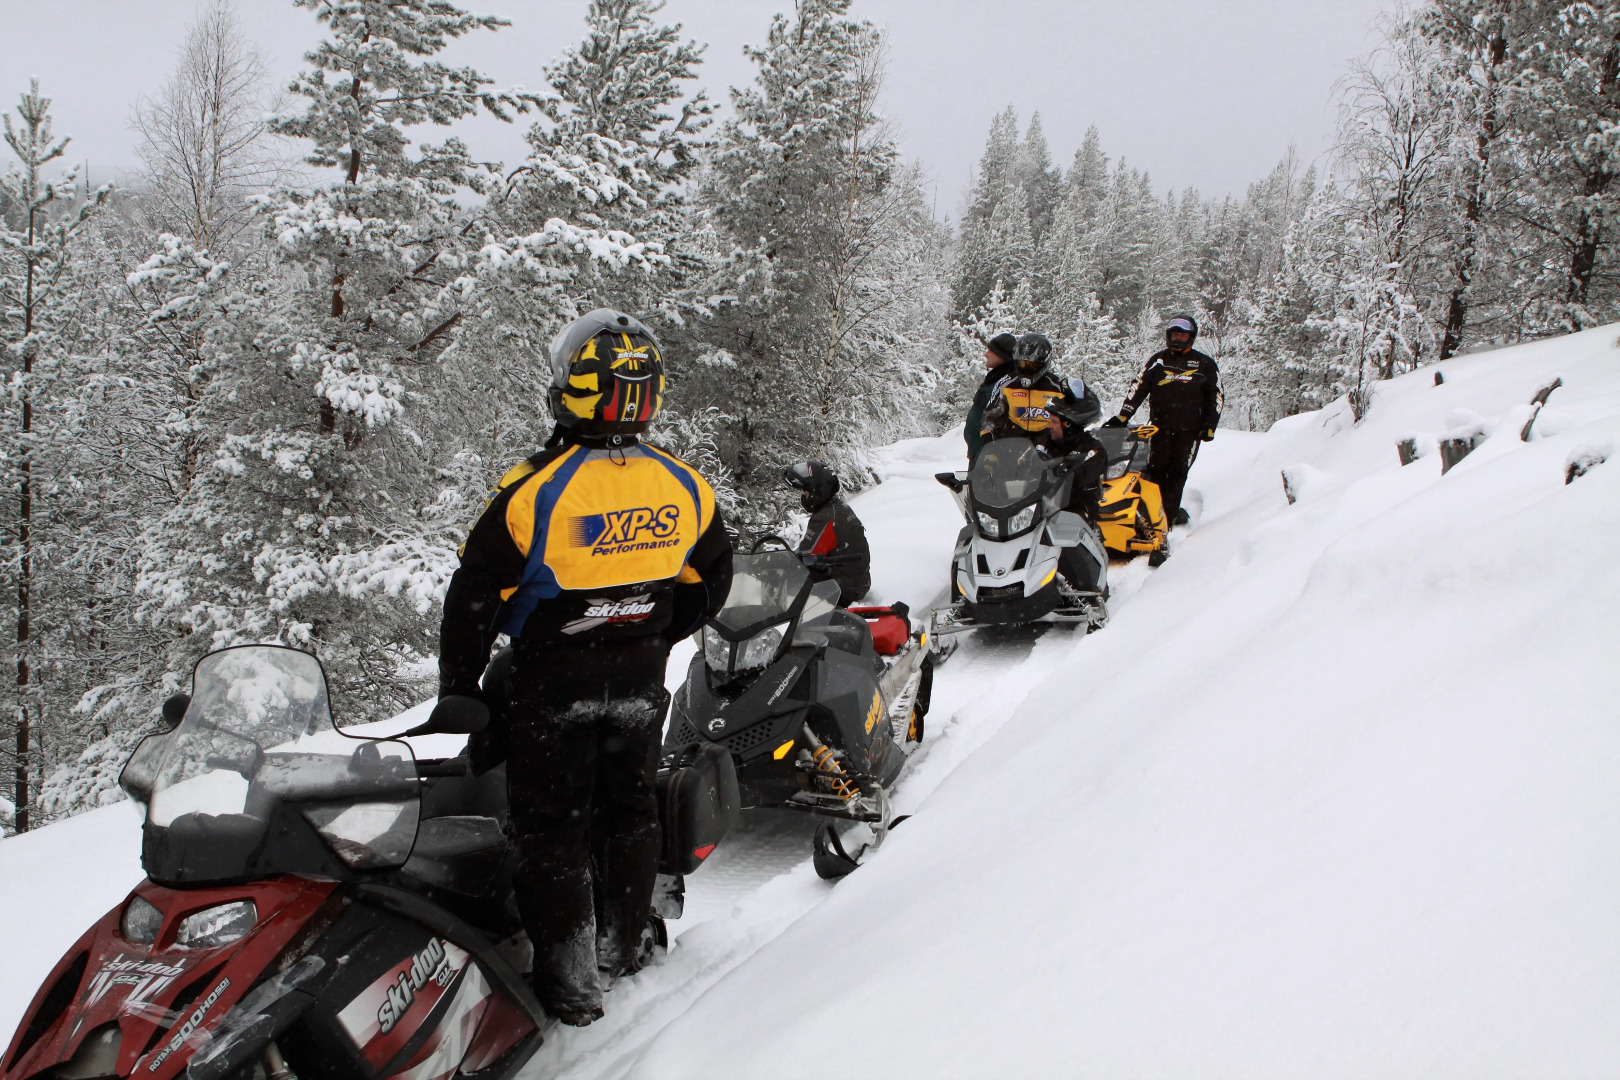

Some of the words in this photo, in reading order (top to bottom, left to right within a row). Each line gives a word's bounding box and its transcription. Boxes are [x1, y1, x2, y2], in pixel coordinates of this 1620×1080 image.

[597, 504, 680, 546] XP-S
[591, 538, 680, 557] Performance
[584, 602, 656, 617] ski-doo
[101, 960, 185, 977] ski-doo
[378, 936, 444, 1034] ski-doo
[148, 1046, 172, 1073] ROTAX
